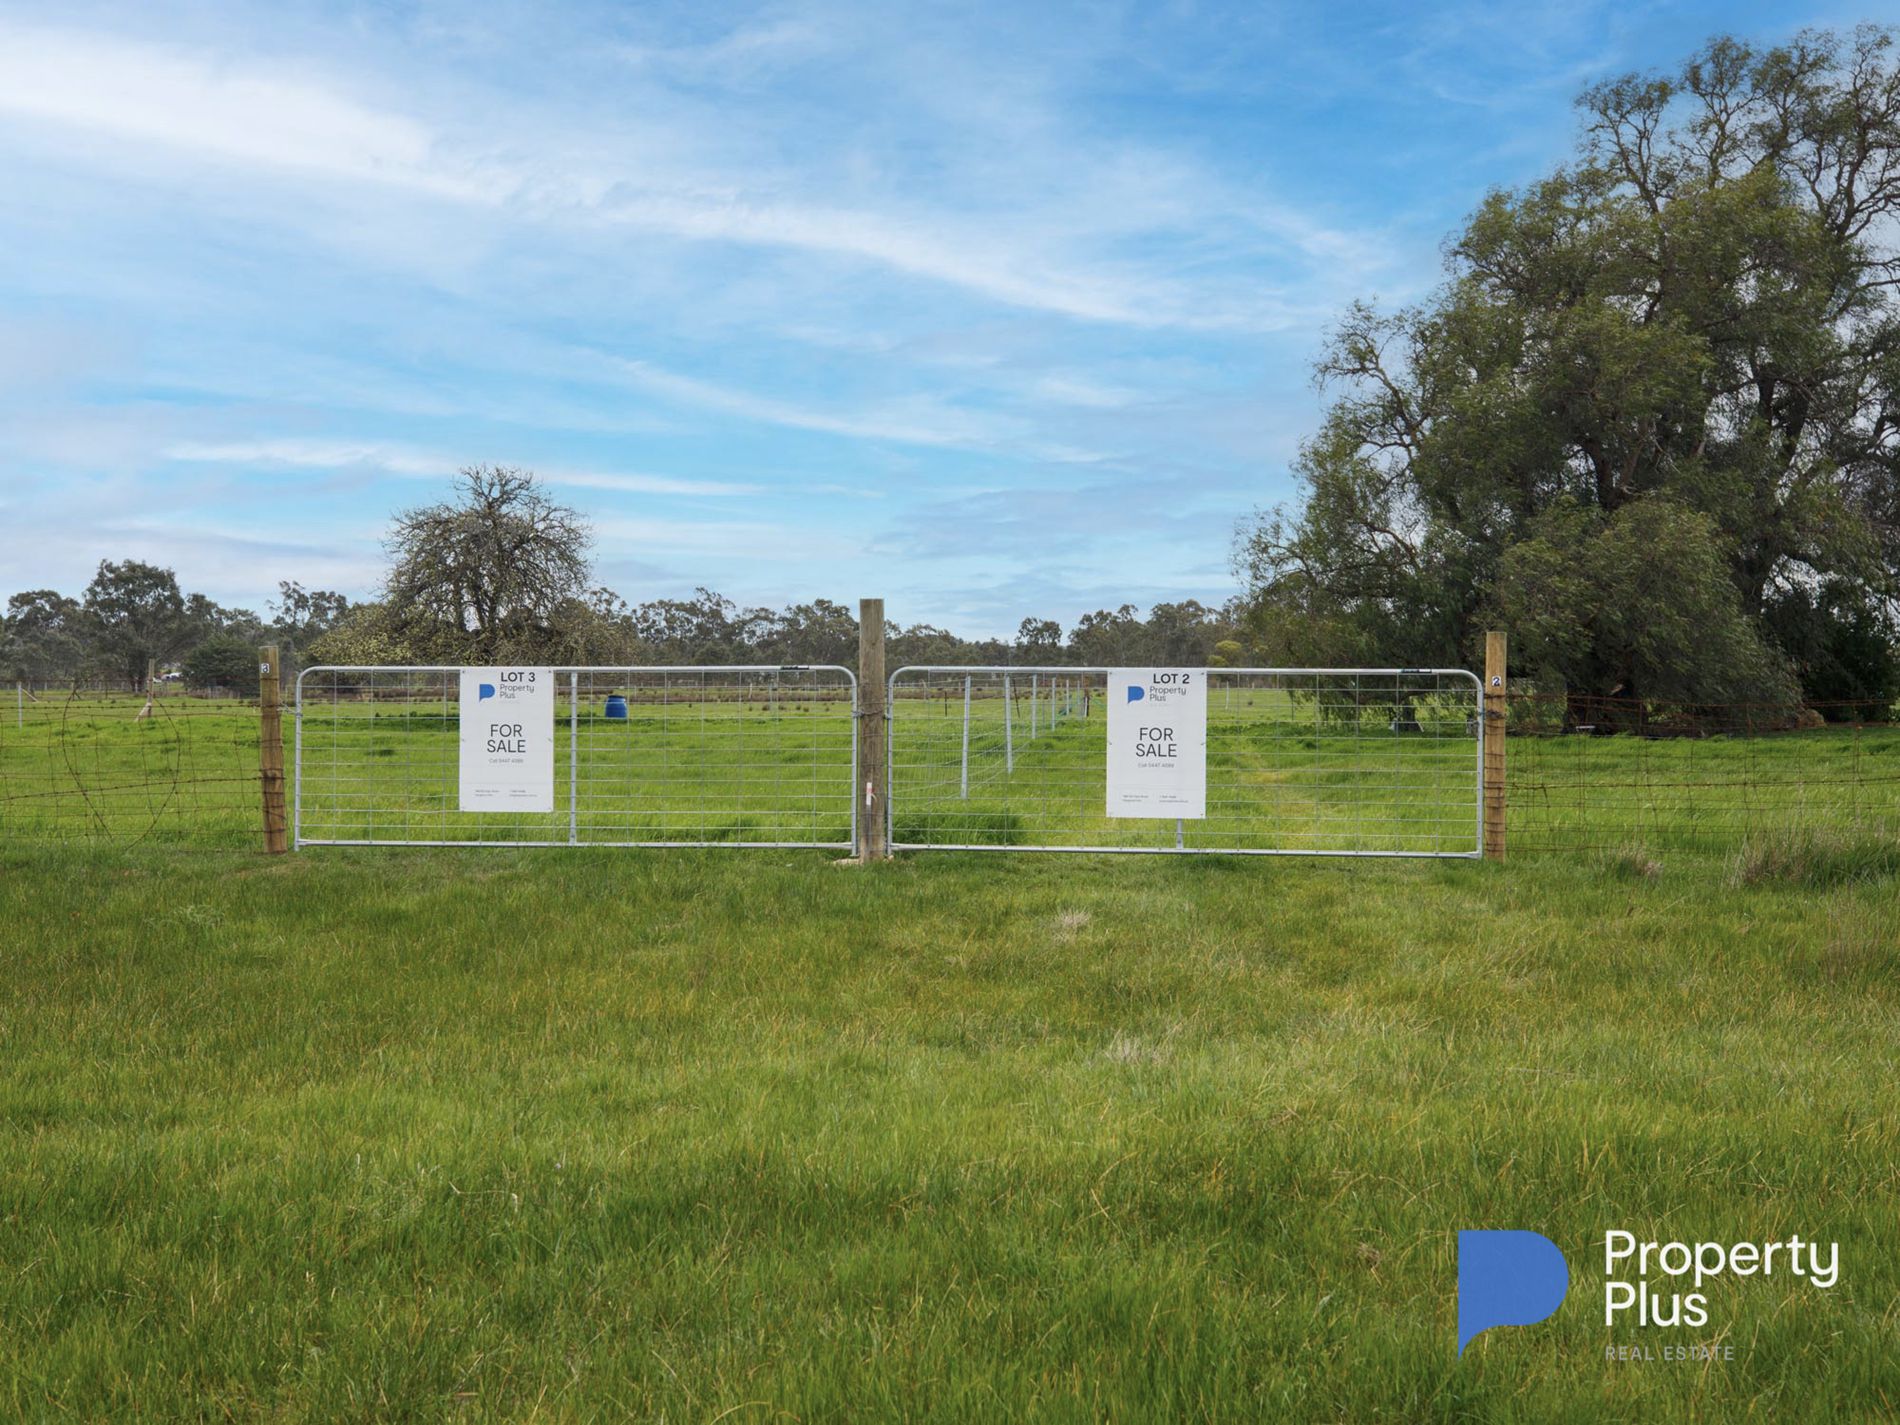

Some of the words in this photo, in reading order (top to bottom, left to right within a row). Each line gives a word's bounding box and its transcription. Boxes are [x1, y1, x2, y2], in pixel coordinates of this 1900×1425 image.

[501, 672, 524, 682] LOT
[528, 672, 536, 682] 3
[1153, 673, 1178, 684] LOT
[1182, 673, 1190, 684] 2
[500, 684, 534, 693] Property
[1149, 686, 1187, 695] Property
[500, 691, 516, 699] Plus
[490, 724, 522, 737] FOR
[1139, 727, 1174, 741] FOR
[487, 739, 526, 753] SALE
[1135, 743, 1177, 757] SALE
